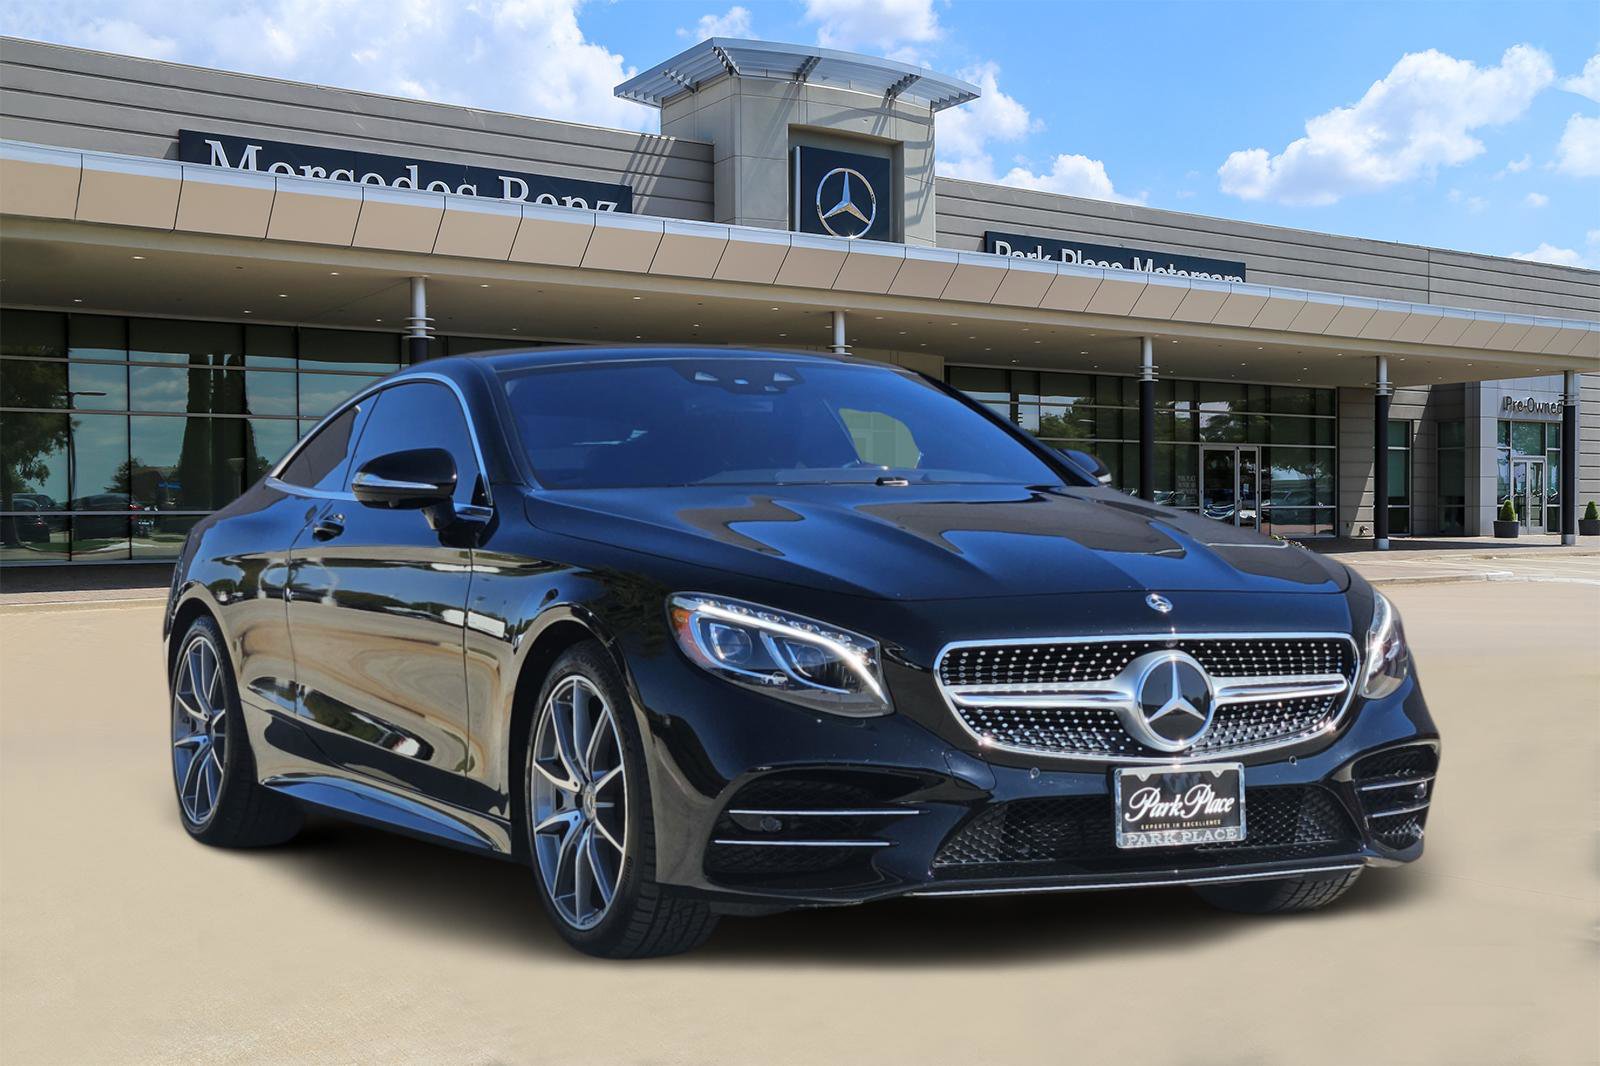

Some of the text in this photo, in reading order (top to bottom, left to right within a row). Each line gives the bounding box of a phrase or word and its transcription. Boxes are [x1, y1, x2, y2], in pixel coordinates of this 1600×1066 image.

[1125, 784, 1235, 822] Park Place
[1126, 828, 1238, 846] PARK PLACE
